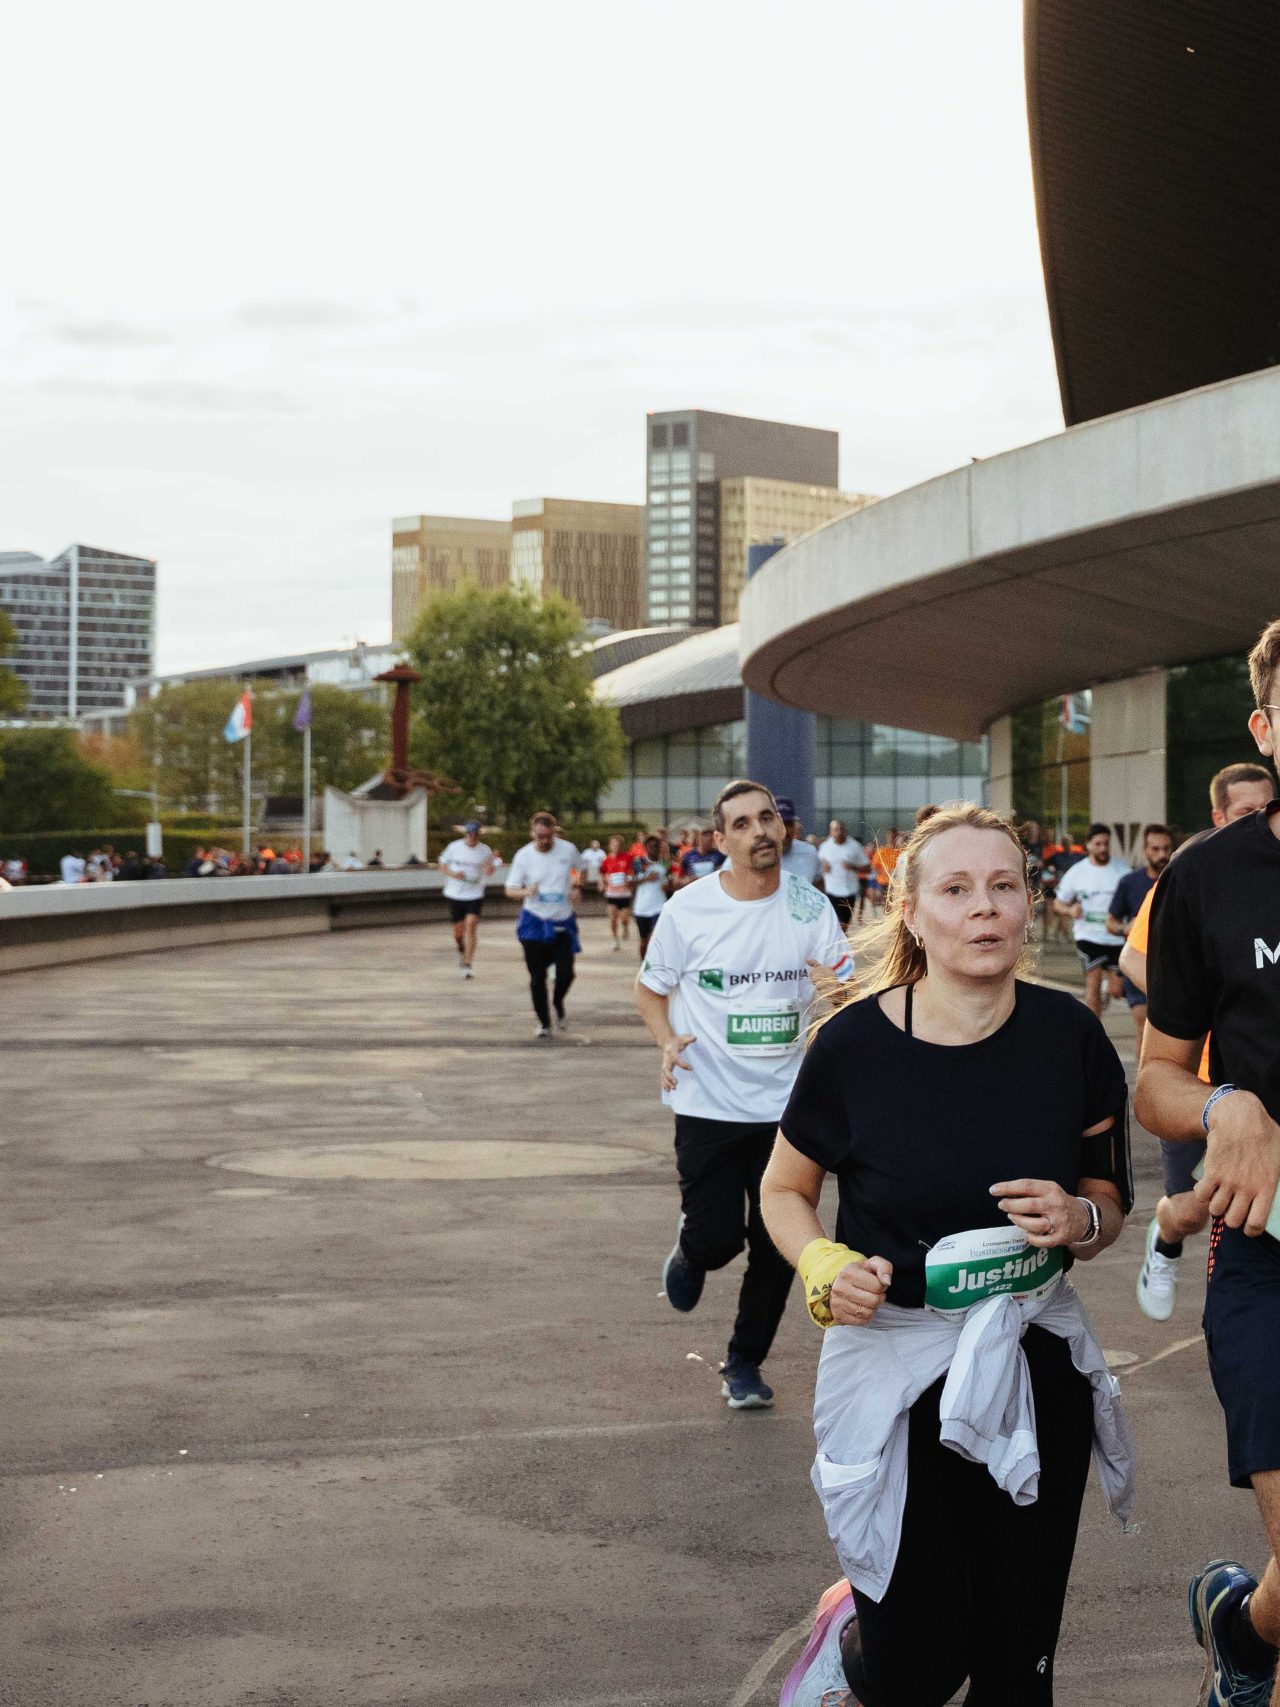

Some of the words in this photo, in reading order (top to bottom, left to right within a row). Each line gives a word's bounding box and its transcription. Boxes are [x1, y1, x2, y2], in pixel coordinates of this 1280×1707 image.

[730, 972, 761, 985] BNP
[732, 1016, 797, 1033] LAURENT
[948, 1248, 1049, 1293] Justine
